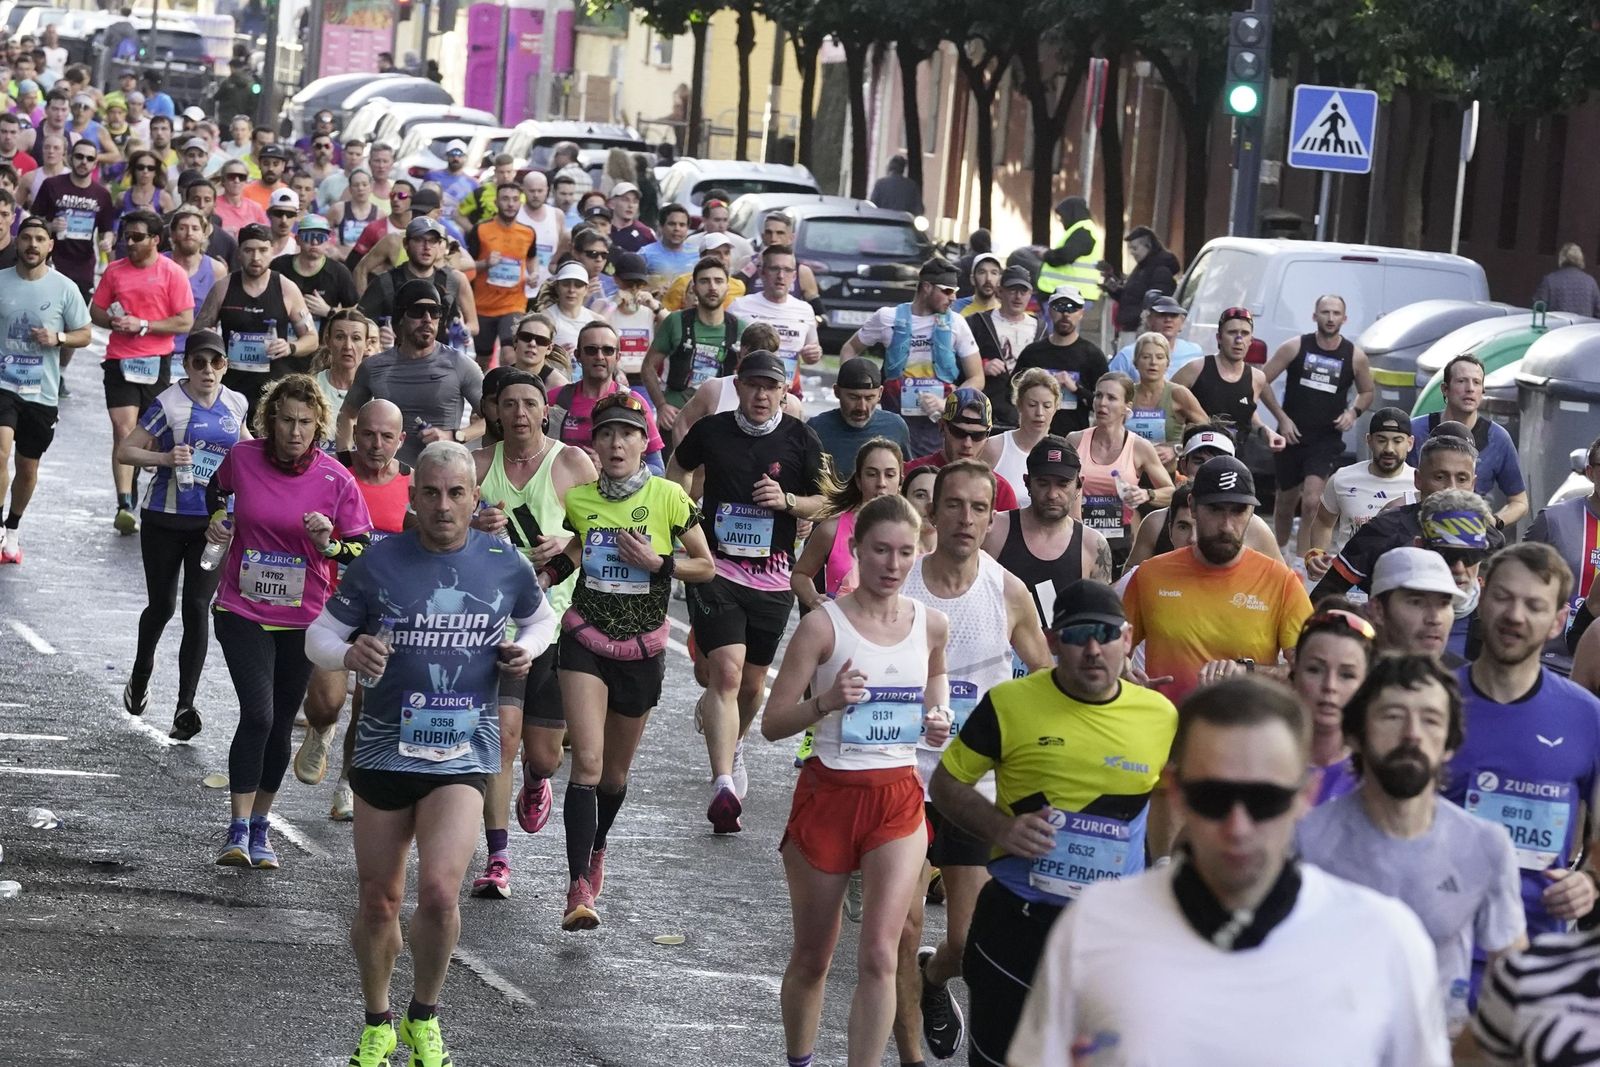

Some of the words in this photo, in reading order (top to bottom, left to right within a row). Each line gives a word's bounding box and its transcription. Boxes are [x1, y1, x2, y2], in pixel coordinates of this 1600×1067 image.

[240, 354, 260, 362] LIAM
[206, 444, 230, 455] ZURIC
[735, 506, 767, 516] ZURICH
[734, 522, 752, 531] 9513
[1083, 517, 1121, 528] ELPHINE
[723, 531, 761, 545] JAVITO
[261, 570, 285, 581] 14762
[602, 565, 629, 579] FITO
[255, 581, 287, 595] RUTH
[415, 613, 490, 629] MEDIA
[431, 697, 473, 707] ZURICH
[875, 692, 917, 701] ZURICH
[872, 710, 893, 721] 8131
[430, 717, 454, 727] 9358
[413, 729, 466, 746] RUBIÑO
[866, 726, 900, 741] JUJU
[1504, 779, 1560, 797] ZURICH
[1071, 818, 1121, 836] ZURICH
[1067, 842, 1096, 857] 6532
[1031, 857, 1066, 876] PEPE
